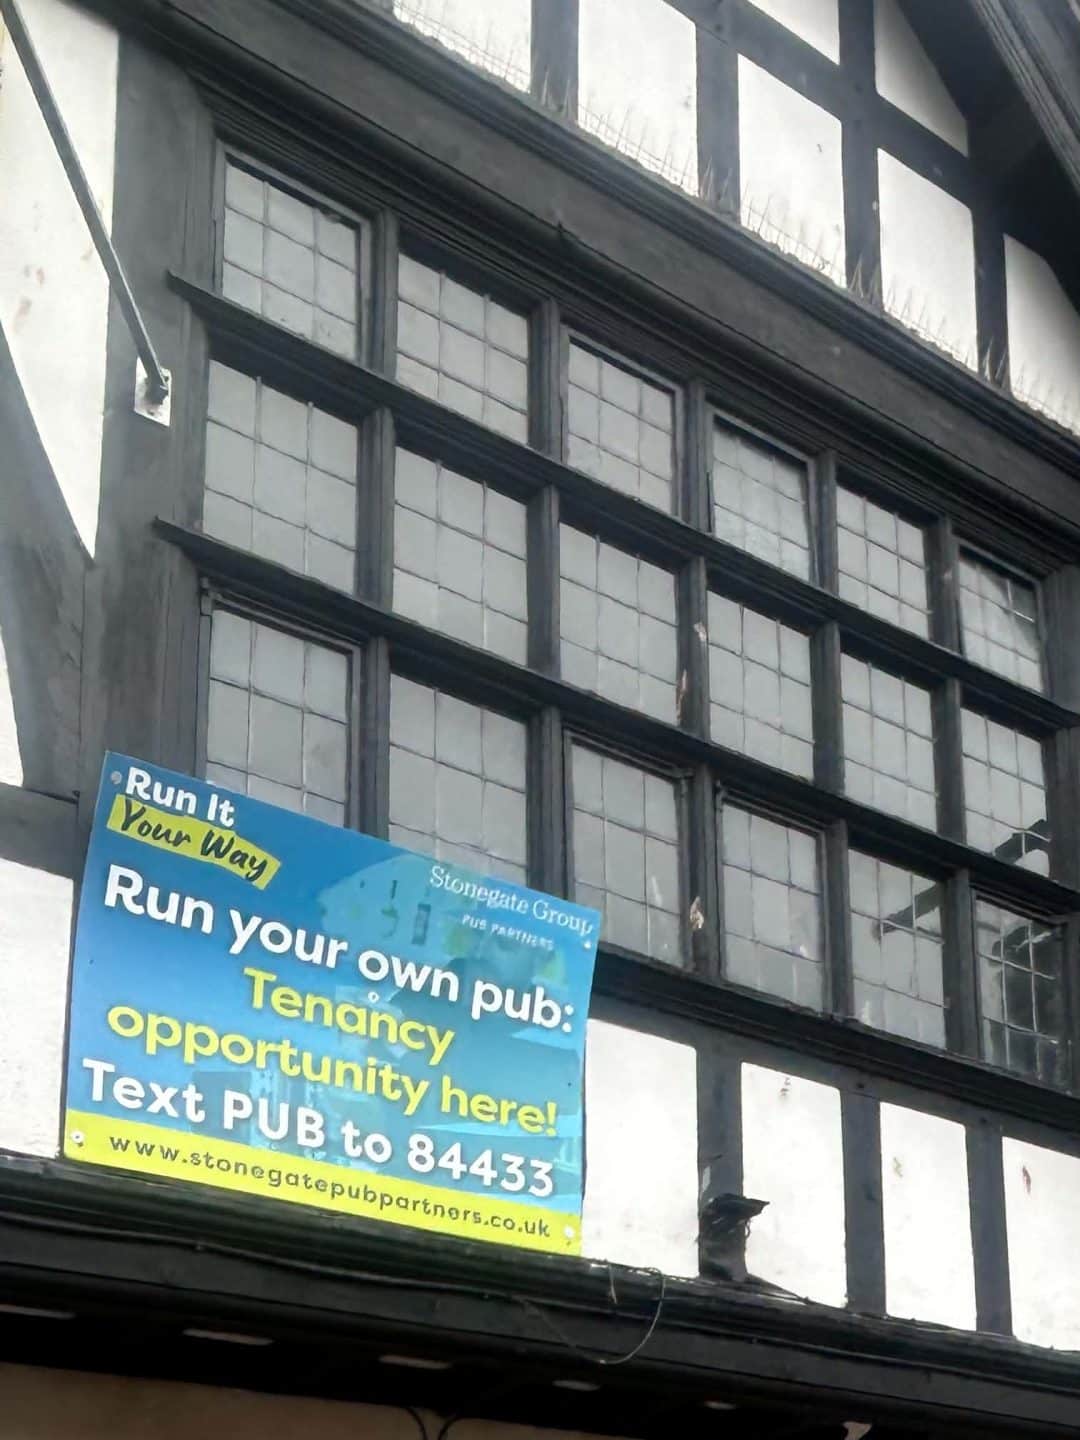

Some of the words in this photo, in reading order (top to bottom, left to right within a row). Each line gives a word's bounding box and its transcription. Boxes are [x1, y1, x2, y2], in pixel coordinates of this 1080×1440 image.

[120, 798, 191, 847] Your
[200, 829, 268, 882] Way
[125, 766, 198, 815] Run
[207, 793, 235, 827] It
[104, 864, 214, 935] Run
[227, 909, 348, 969] your
[357, 949, 459, 1002] own
[470, 979, 575, 1033] pub:
[429, 865, 529, 914] Stonegate
[533, 899, 594, 937] Group
[491, 923, 554, 950] PARTNERS
[243, 967, 455, 1066] Tenancy
[106, 1005, 430, 1116] opportunity
[441, 1074, 559, 1137] here!
[82, 1058, 206, 1124] Text
[223, 1090, 326, 1149] PUB
[340, 1120, 393, 1163] to
[407, 1135, 555, 1198] 84433
[108, 1135, 551, 1239] www.stonegatepubpartners.co.uk
